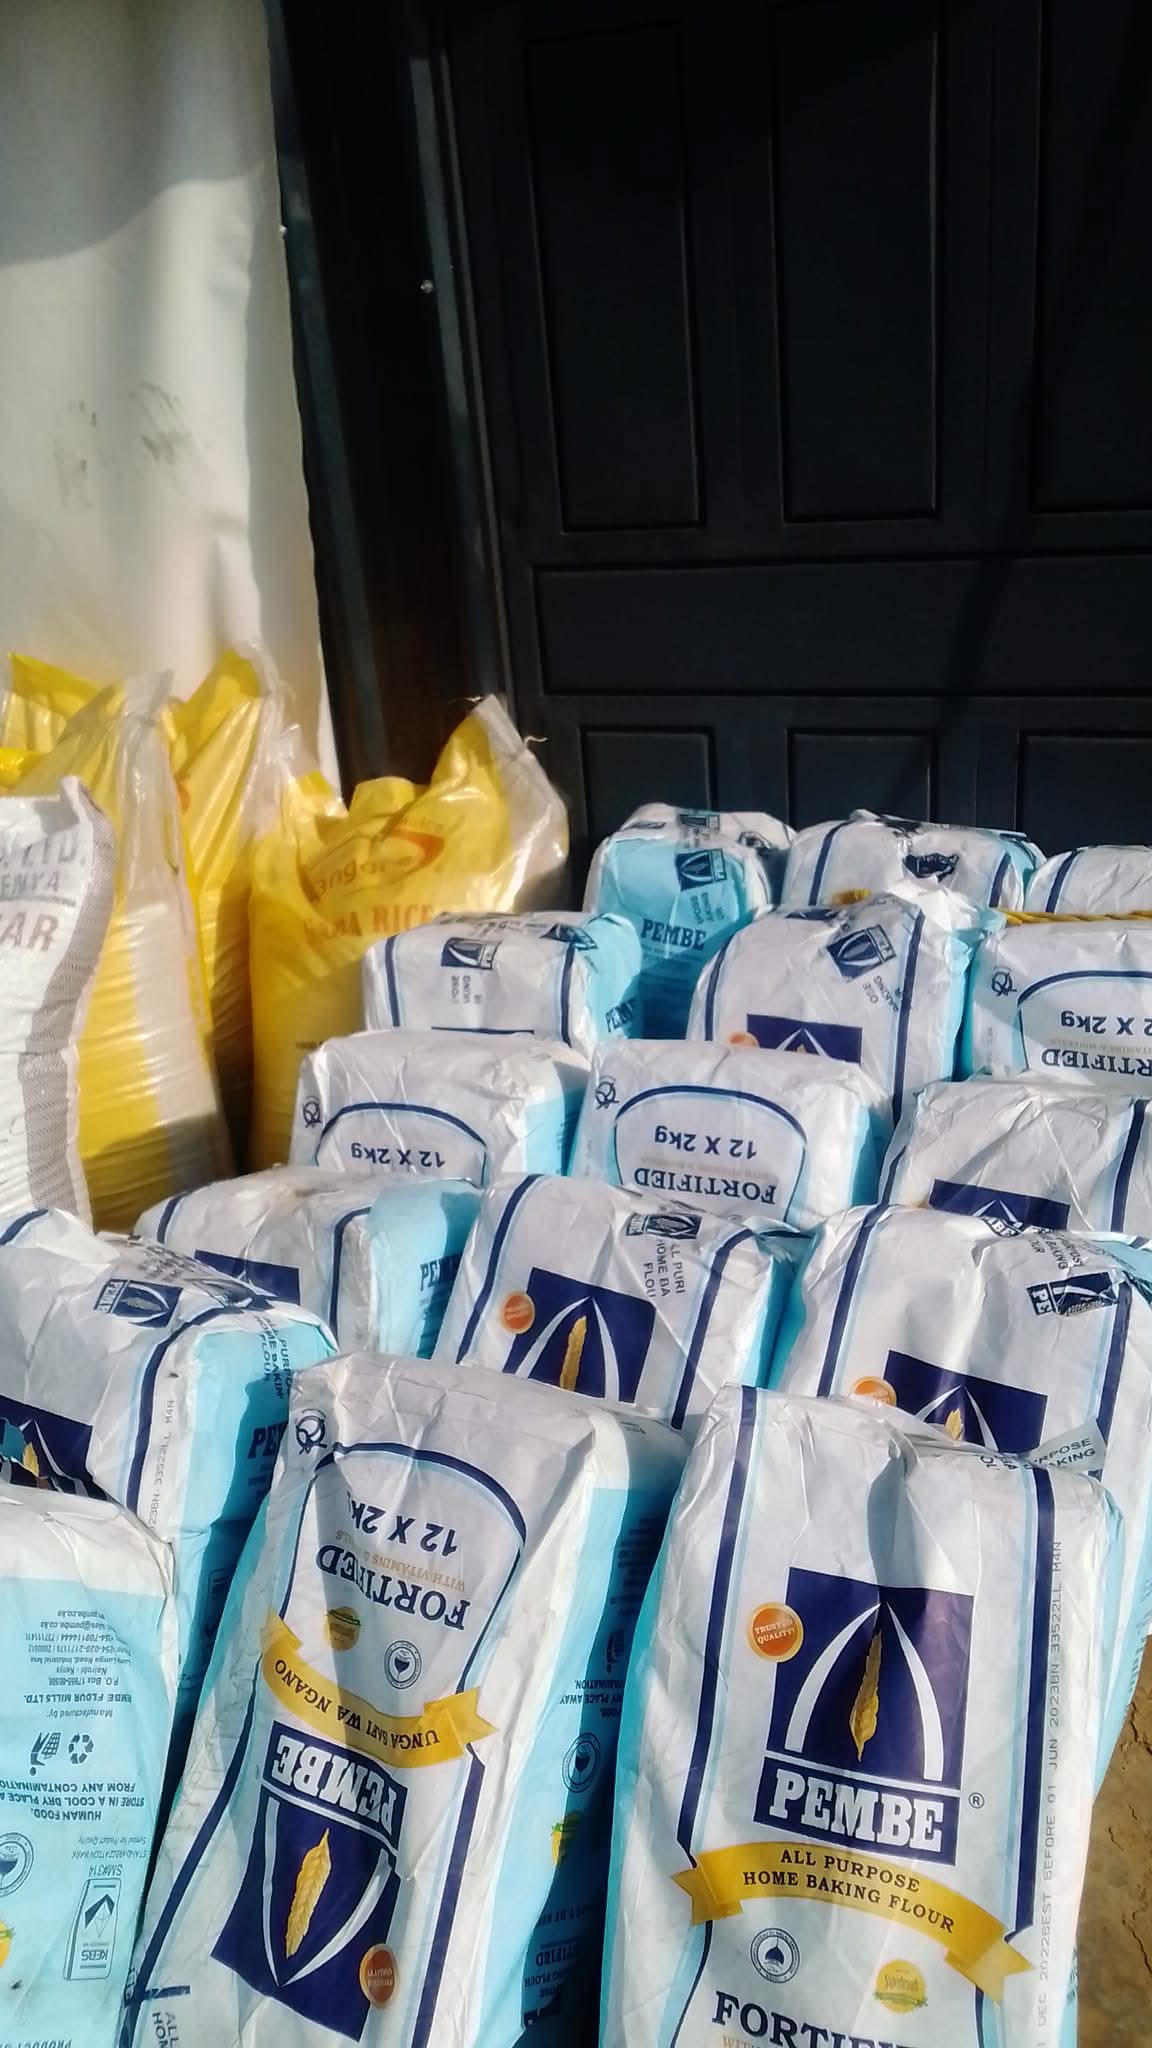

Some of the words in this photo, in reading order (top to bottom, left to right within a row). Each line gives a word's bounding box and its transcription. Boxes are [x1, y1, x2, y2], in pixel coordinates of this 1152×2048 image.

[641, 918, 707, 951] PEMBE
[1061, 1010, 1108, 1035] 2kg
[1116, 1017, 1135, 1036] X
[654, 1125, 696, 1151] 2kg
[703, 1135, 721, 1155] X
[351, 1142, 391, 1166] 2kg
[399, 1148, 412, 1167] X
[420, 1149, 446, 1168] 12
[729, 1139, 757, 1160] 12
[633, 1166, 777, 1205] FORTIFIED
[348, 1490, 386, 1534] 2k
[387, 1515, 416, 1544] X
[420, 1523, 458, 1557] 12
[274, 1658, 333, 1714] NGANO
[24, 1694, 45, 1704] LTD.
[46, 1694, 72, 1703] MILLS
[74, 1692, 104, 1703] FLOUR
[560, 1693, 584, 1704] AWAY
[58, 1708, 113, 1718] Manufactured
[336, 1705, 362, 1731] WA
[390, 1728, 441, 1750] UNGA
[1048, 1739, 1059, 1769] JUN
[82, 1783, 104, 1793] ANY
[107, 1783, 136, 1793] FROM
[271, 1734, 398, 1836] PEMBE
[8, 1792, 39, 1804] PLACE
[42, 1796, 62, 1807] DRY
[98, 1797, 105, 1806] A
[109, 1797, 119, 1807] IN
[120, 1797, 145, 1807] STORE
[31, 1808, 61, 1820] FOOD.
[63, 1810, 102, 1821] HUMAN
[768, 1768, 945, 1853] PEMBE
[1043, 1815, 1056, 1881] BEFORE
[781, 1849, 817, 1867] ALL
[823, 1855, 921, 1892] PURPOSE
[743, 1871, 799, 1887] HOME
[806, 1875, 881, 1903] BAKING
[888, 1895, 955, 1934] FLOUR
